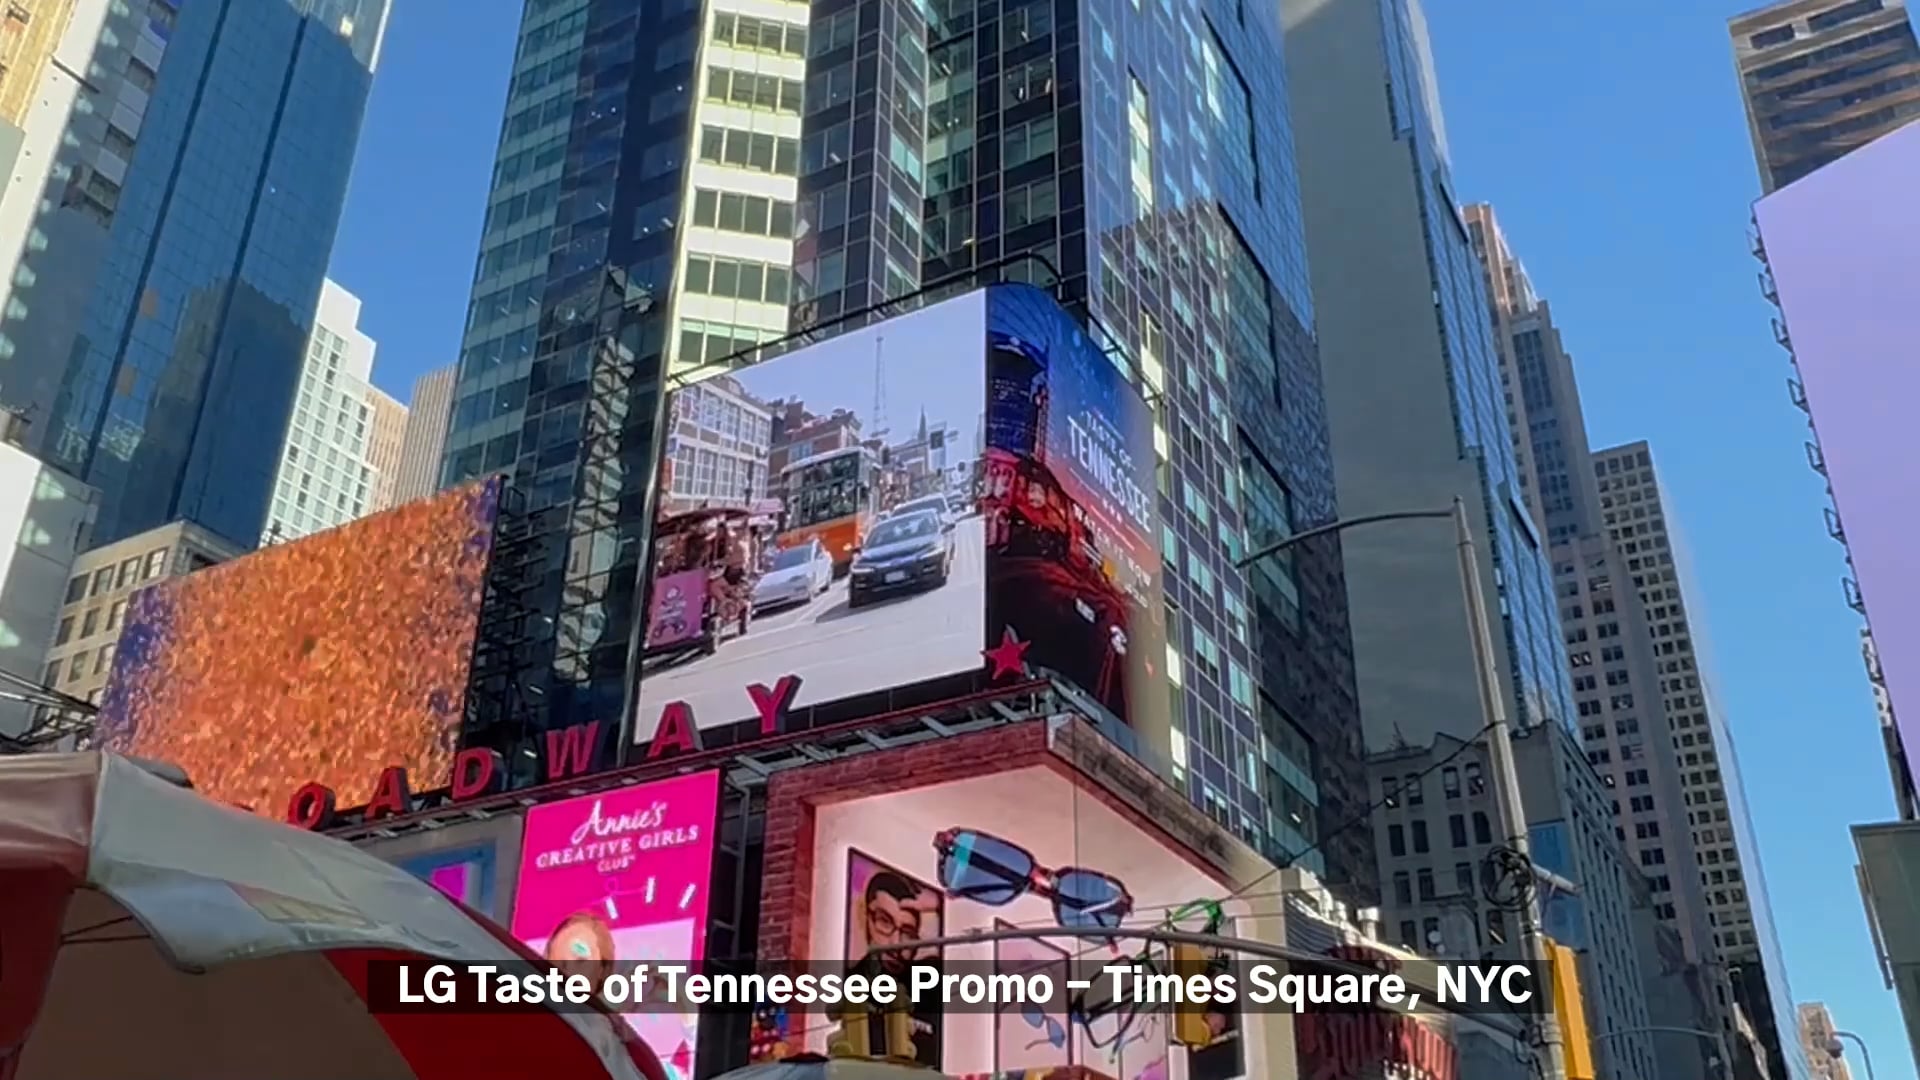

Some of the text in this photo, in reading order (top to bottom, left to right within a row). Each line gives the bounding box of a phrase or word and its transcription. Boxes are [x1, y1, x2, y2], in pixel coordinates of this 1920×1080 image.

[1067, 414, 1152, 533] TENNESSEE
[571, 799, 668, 845] Annie's
[535, 825, 700, 869] CREATIVE GIRLS
